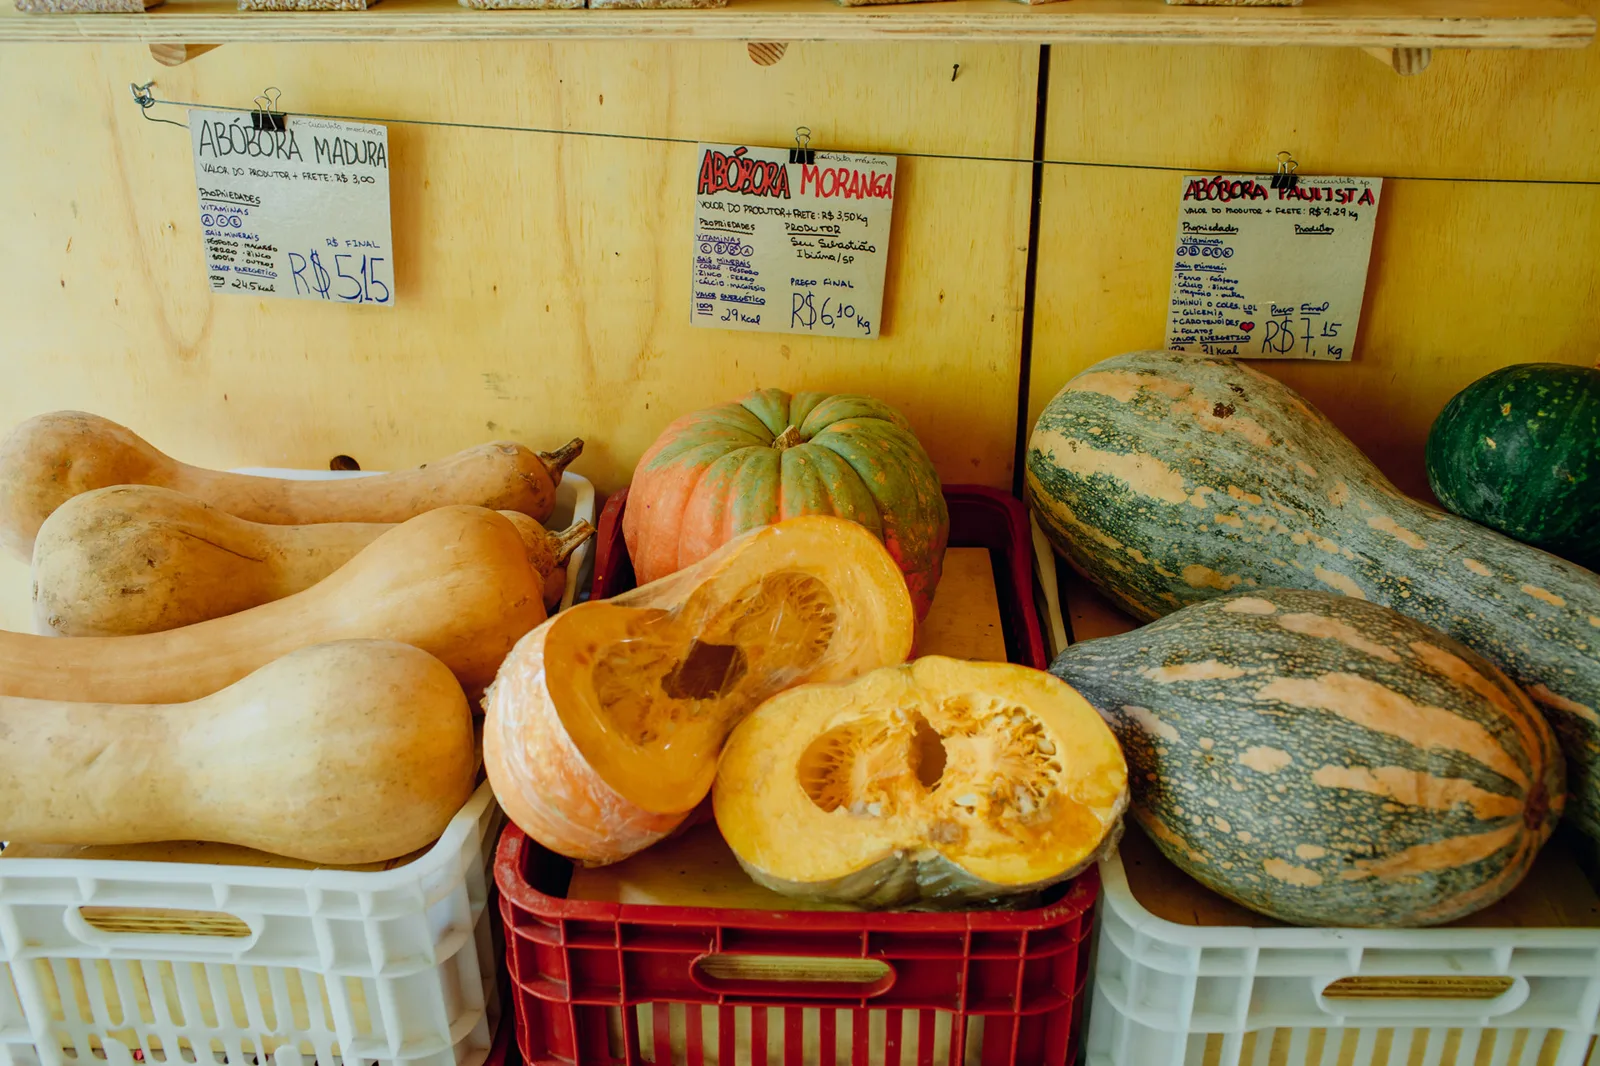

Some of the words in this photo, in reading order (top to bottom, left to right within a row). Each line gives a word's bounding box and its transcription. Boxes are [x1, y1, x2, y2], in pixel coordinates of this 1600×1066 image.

[199, 117, 303, 162] ABÓBORA
[313, 135, 387, 168] MADURA
[200, 162, 229, 175] VALOR
[232, 167, 244, 176] DO
[248, 167, 291, 180] PRODUTOR
[697, 145, 792, 200] ABÓBORA
[800, 163, 893, 200] MORANGA
[1183, 175, 1269, 203] ABÓBORA
[1278, 183, 1375, 206] PAULISTA
[727, 202, 741, 213] DO
[1183, 207, 1207, 215] VALOR
[1225, 207, 1263, 215] PRODUTOR
[699, 217, 756, 232] PROPRIEDADES
[784, 222, 841, 235] PRODUTOR
[345, 239, 381, 249] FINAL
[790, 277, 817, 288] PREÇO
[720, 308, 739, 321] 29
